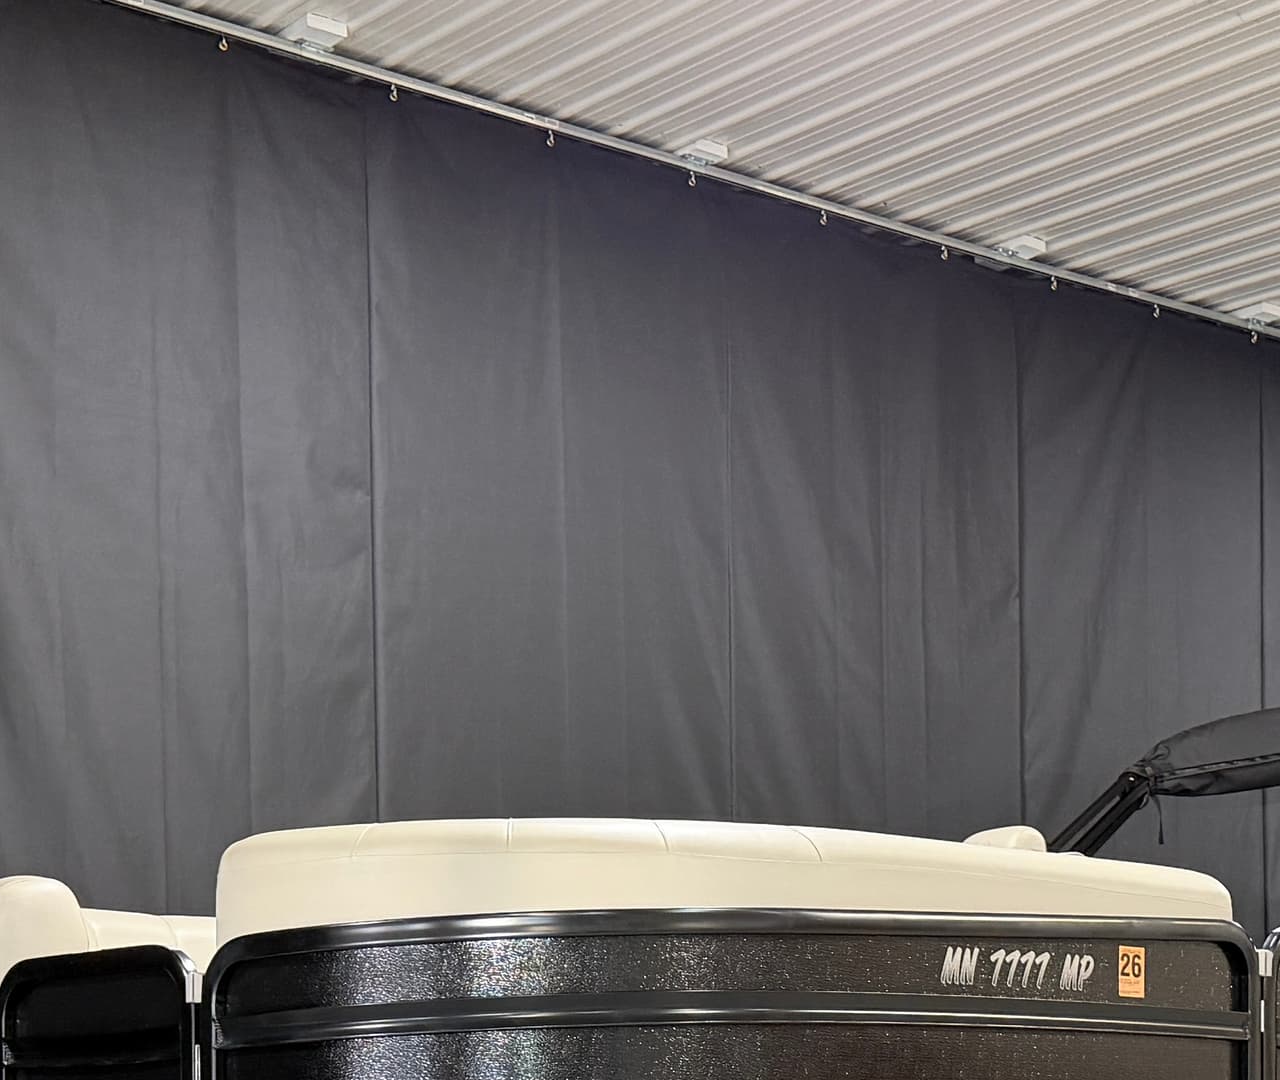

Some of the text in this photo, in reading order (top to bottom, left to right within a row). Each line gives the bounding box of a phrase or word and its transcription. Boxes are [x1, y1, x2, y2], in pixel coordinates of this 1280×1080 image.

[940, 945, 980, 986] MN
[1059, 953, 1095, 991] MP
[1120, 952, 1142, 978] 26
